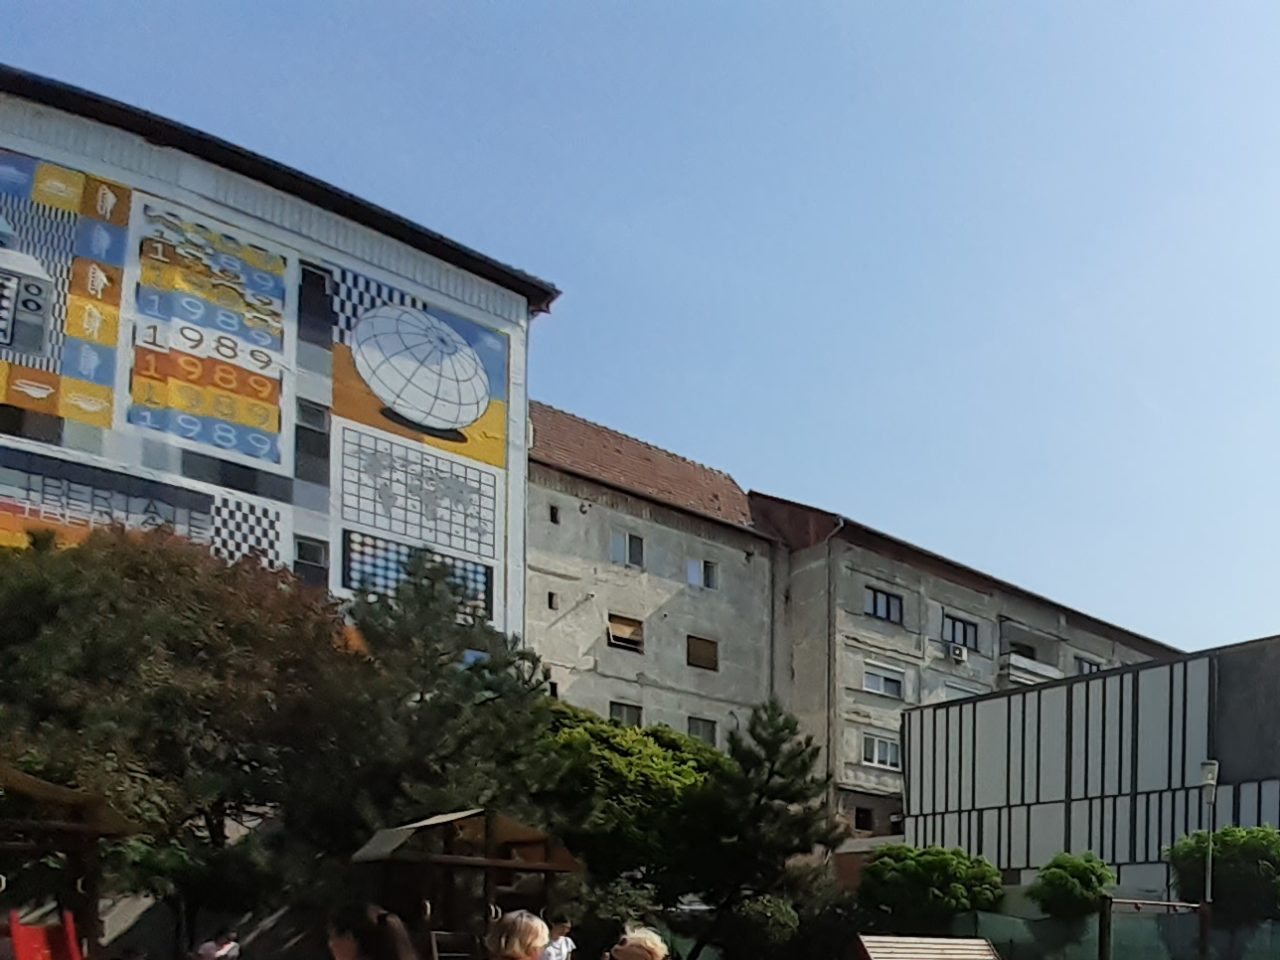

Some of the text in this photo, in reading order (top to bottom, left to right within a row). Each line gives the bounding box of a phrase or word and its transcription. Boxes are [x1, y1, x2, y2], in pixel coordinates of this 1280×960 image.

[145, 295, 273, 346] 1989
[143, 325, 273, 369] 1989
[140, 354, 273, 398] 1989
[138, 411, 272, 455] 1989
